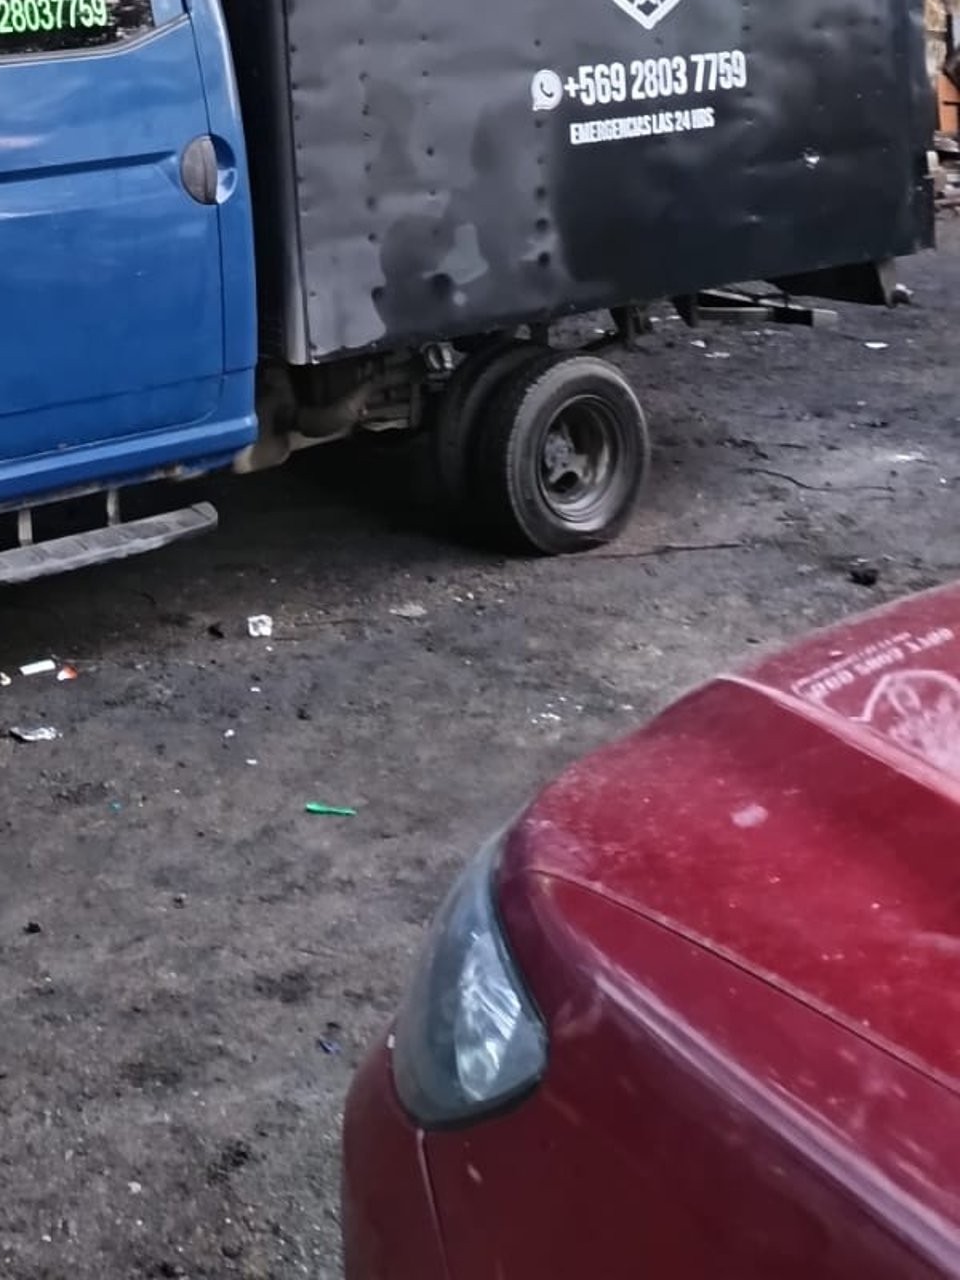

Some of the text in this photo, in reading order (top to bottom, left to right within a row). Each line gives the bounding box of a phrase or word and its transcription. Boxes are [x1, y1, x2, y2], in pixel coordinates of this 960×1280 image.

[564, 49, 748, 106] +569 2803 7759
